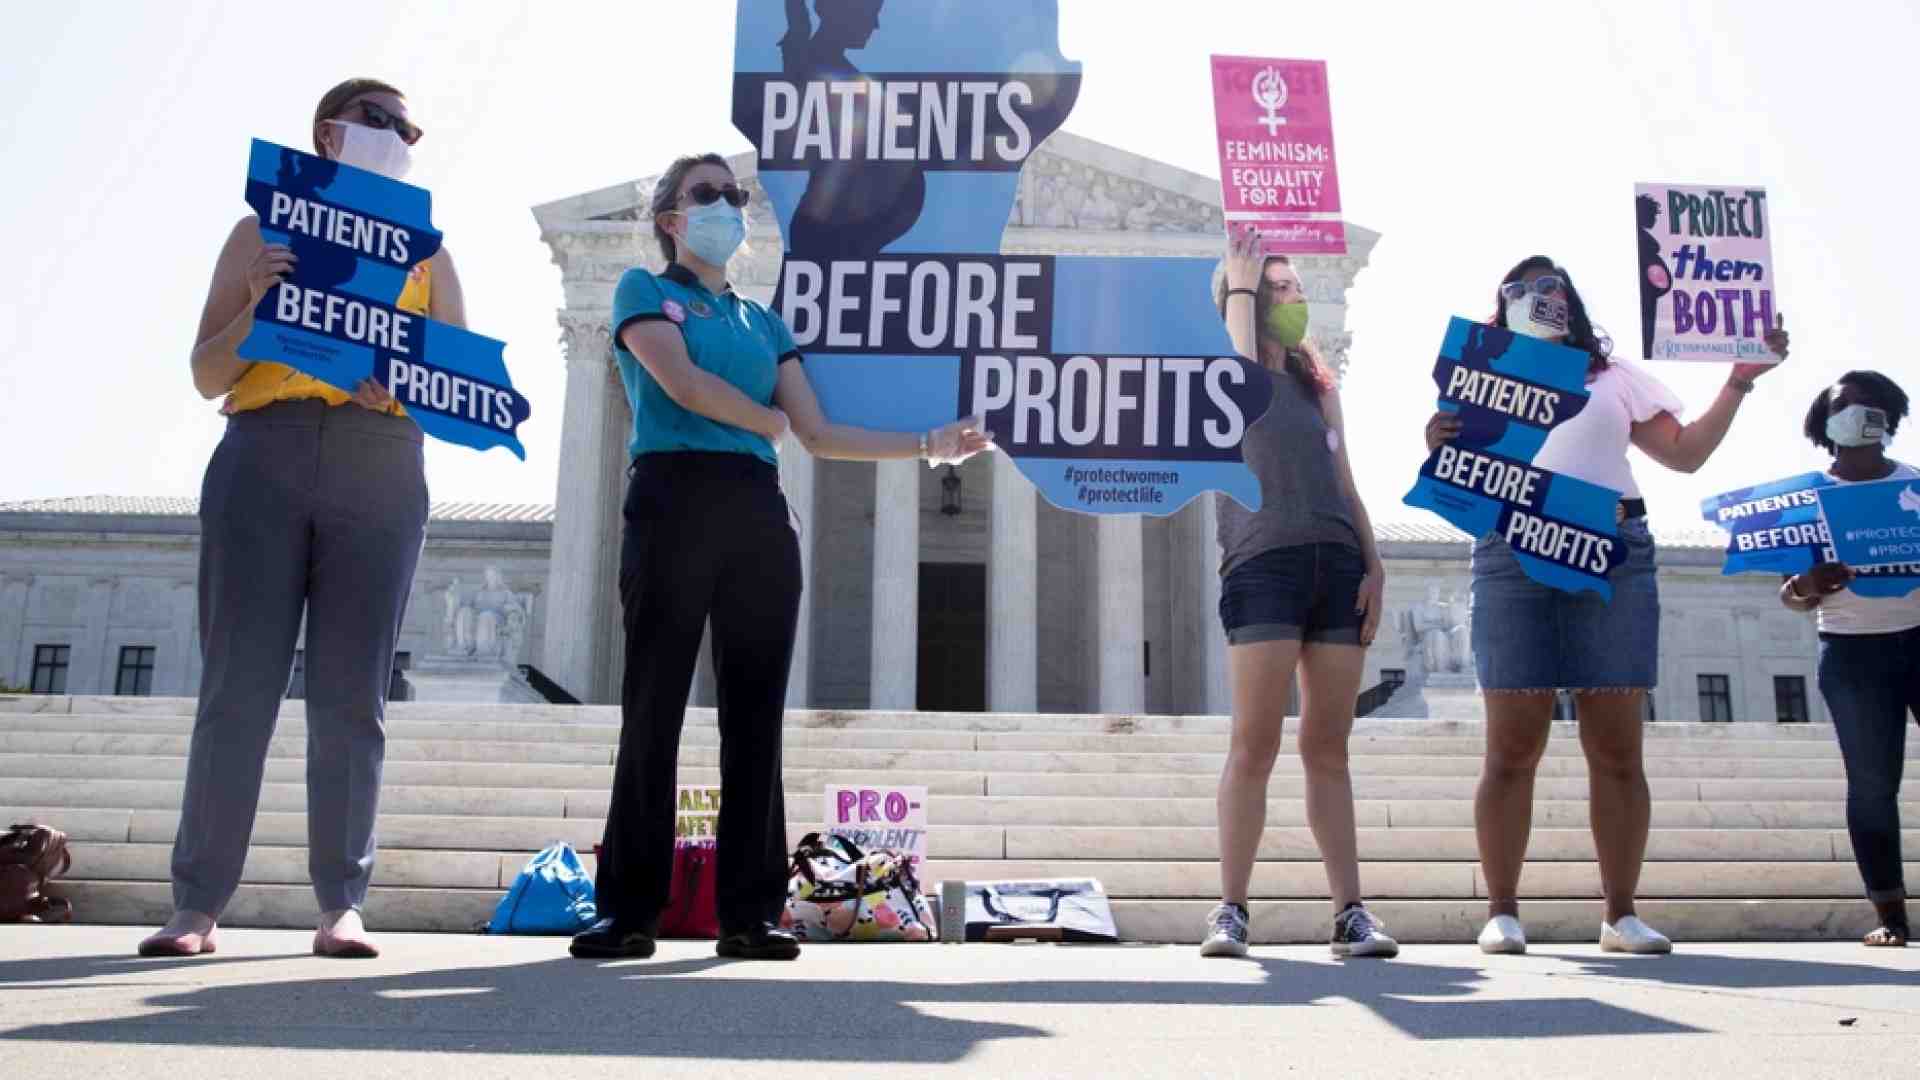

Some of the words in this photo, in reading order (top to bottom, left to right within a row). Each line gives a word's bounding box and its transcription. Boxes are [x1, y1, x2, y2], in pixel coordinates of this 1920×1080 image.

[761, 80, 1033, 162] PATIENTS
[1226, 141, 1329, 161] FEMINISM:
[1231, 168, 1324, 187] EQUALITY
[1240, 188, 1279, 205] FOR
[270, 191, 411, 264] PATIENTS
[1667, 189, 1767, 239] PROTECT
[1672, 244, 1763, 281] them
[276, 281, 413, 354] BEFORE
[782, 260, 1042, 350] BEFORE
[1672, 289, 1773, 337] BOTH
[388, 357, 514, 430] PROFITS
[972, 355, 1247, 449] PROFITS
[1447, 365, 1561, 426] PATIENTS
[1064, 464, 1180, 486] #protectwomen
[1078, 485, 1165, 505] #protectlife
[1434, 445, 1542, 507] BEFORE
[1718, 489, 1818, 521] PATIENTS
[1506, 511, 1614, 574] PROFITS
[837, 789, 921, 824] PRO-
